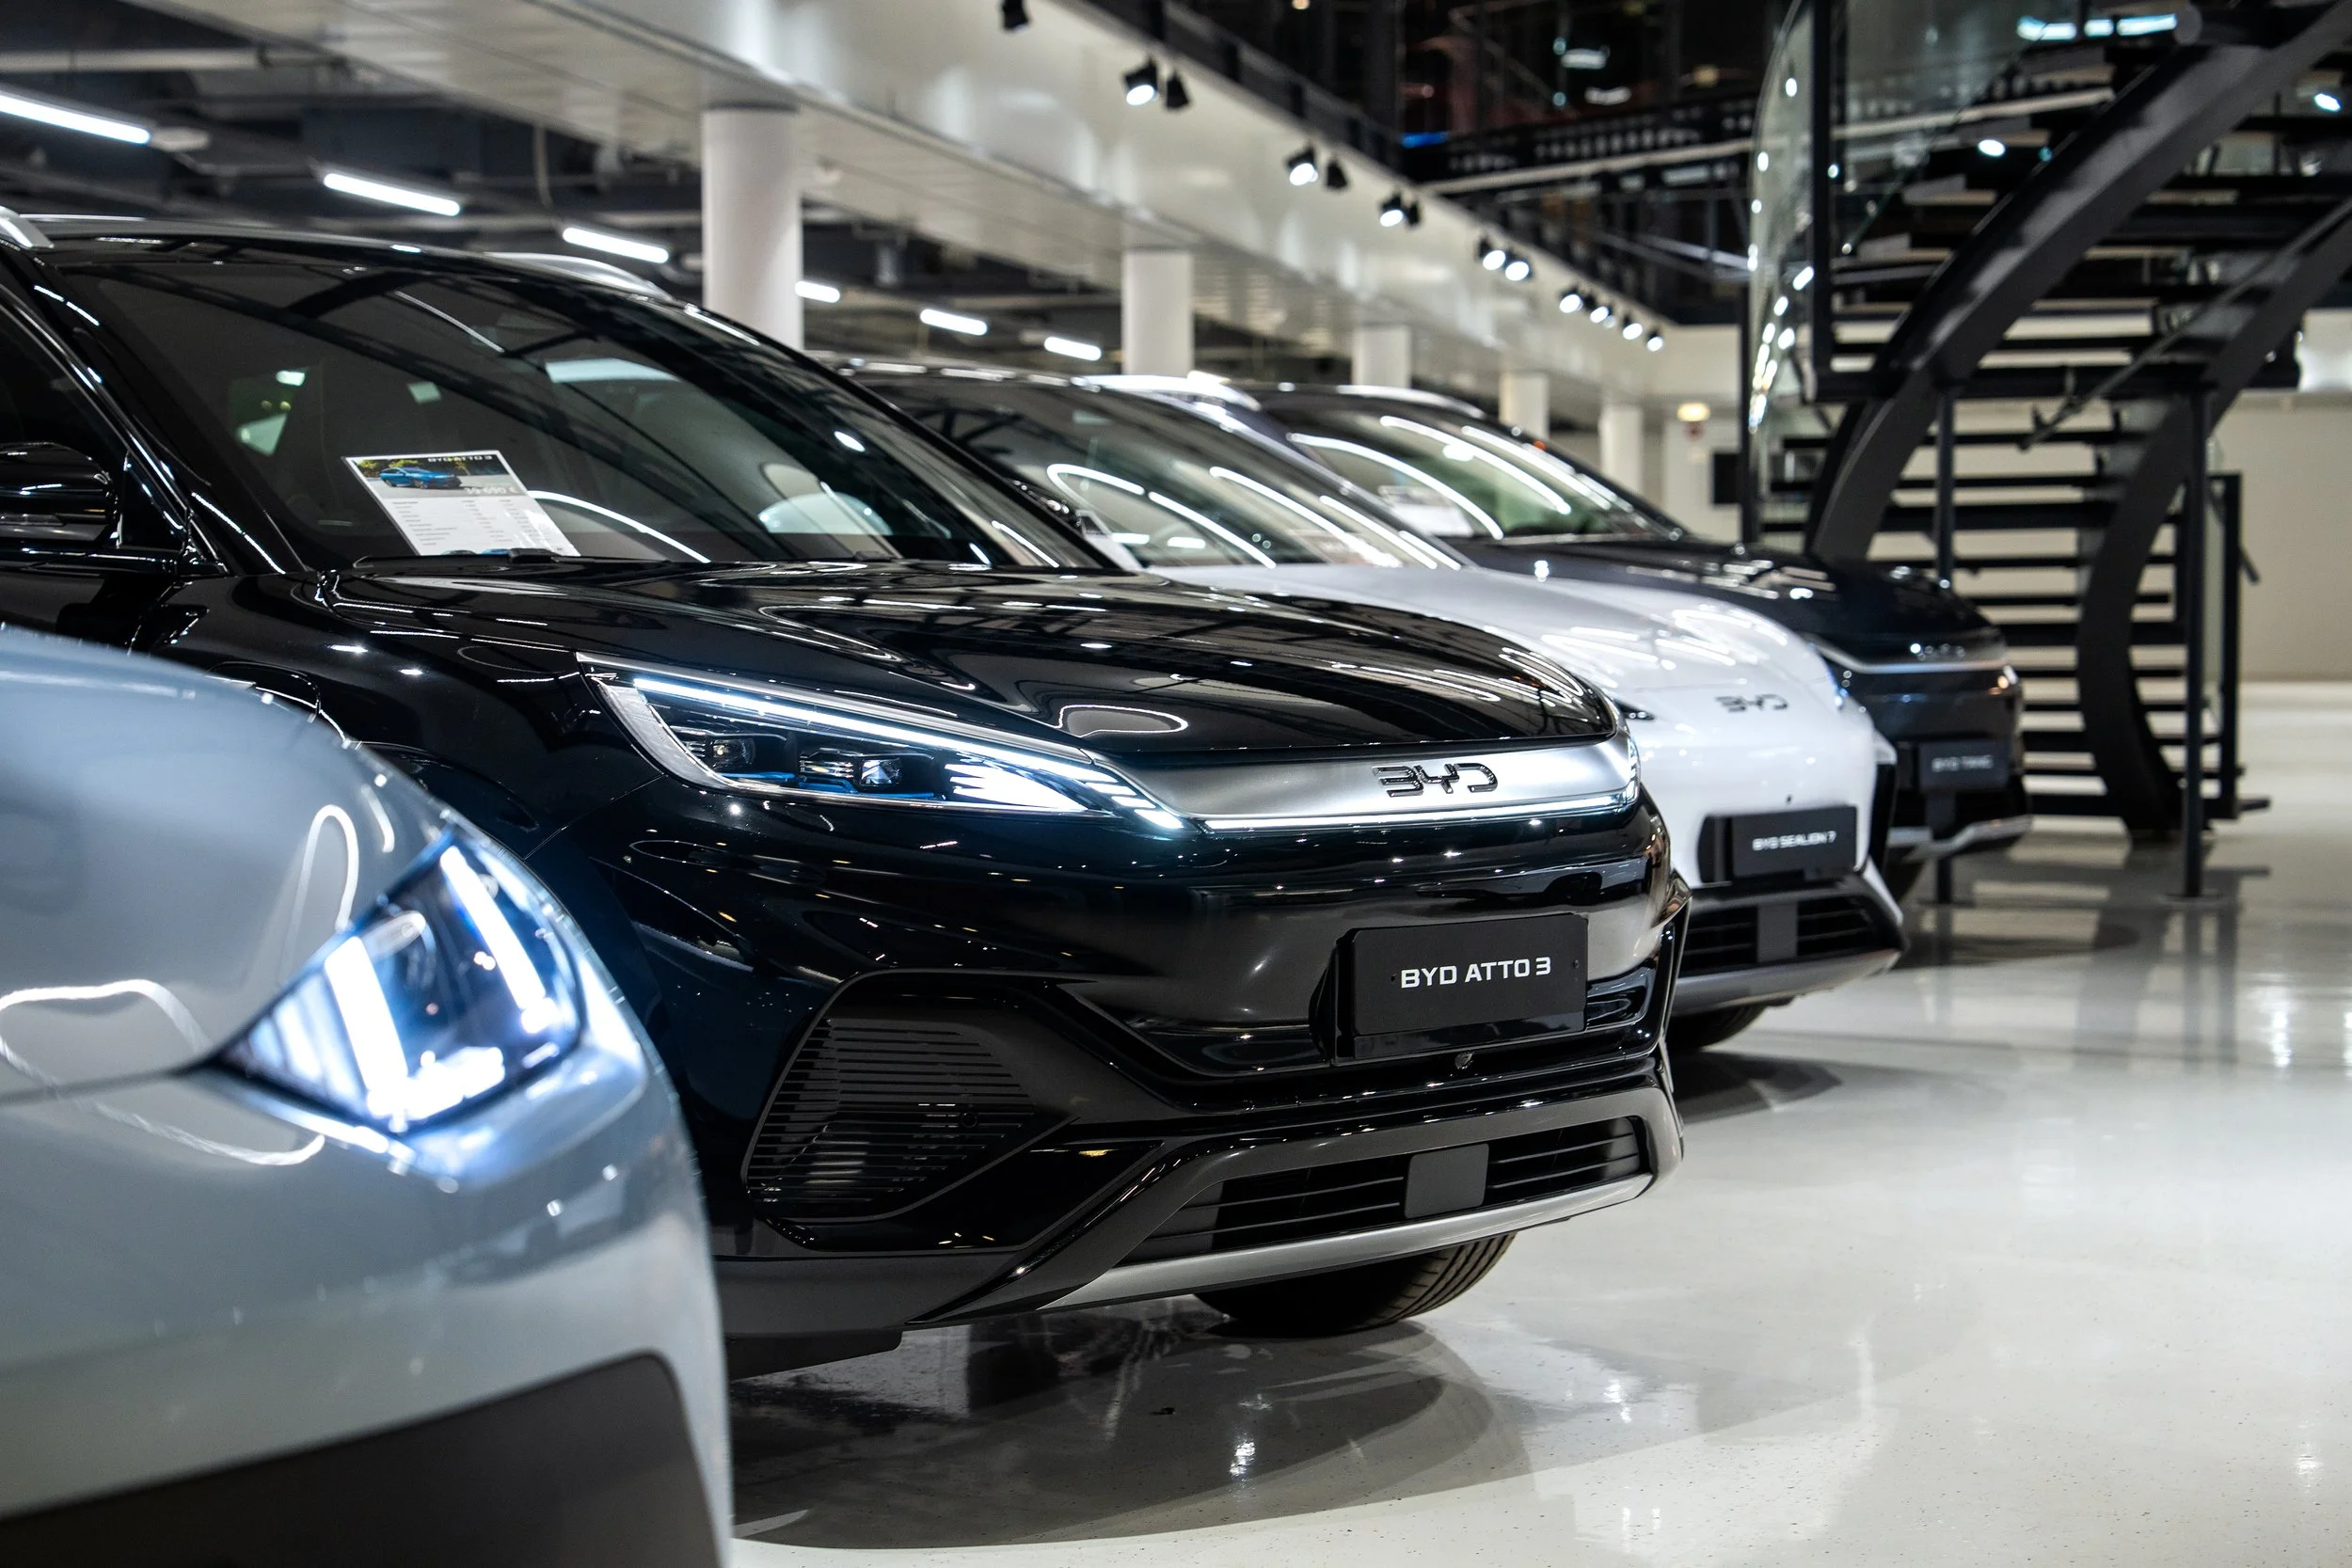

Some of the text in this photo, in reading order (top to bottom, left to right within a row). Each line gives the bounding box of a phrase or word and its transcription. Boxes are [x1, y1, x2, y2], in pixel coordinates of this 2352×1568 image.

[1715, 693, 1788, 713] BYD
[1372, 763, 1498, 798] BYD
[1753, 836, 1779, 851] BYD
[1401, 957, 1551, 989] BYD ATTO 3
